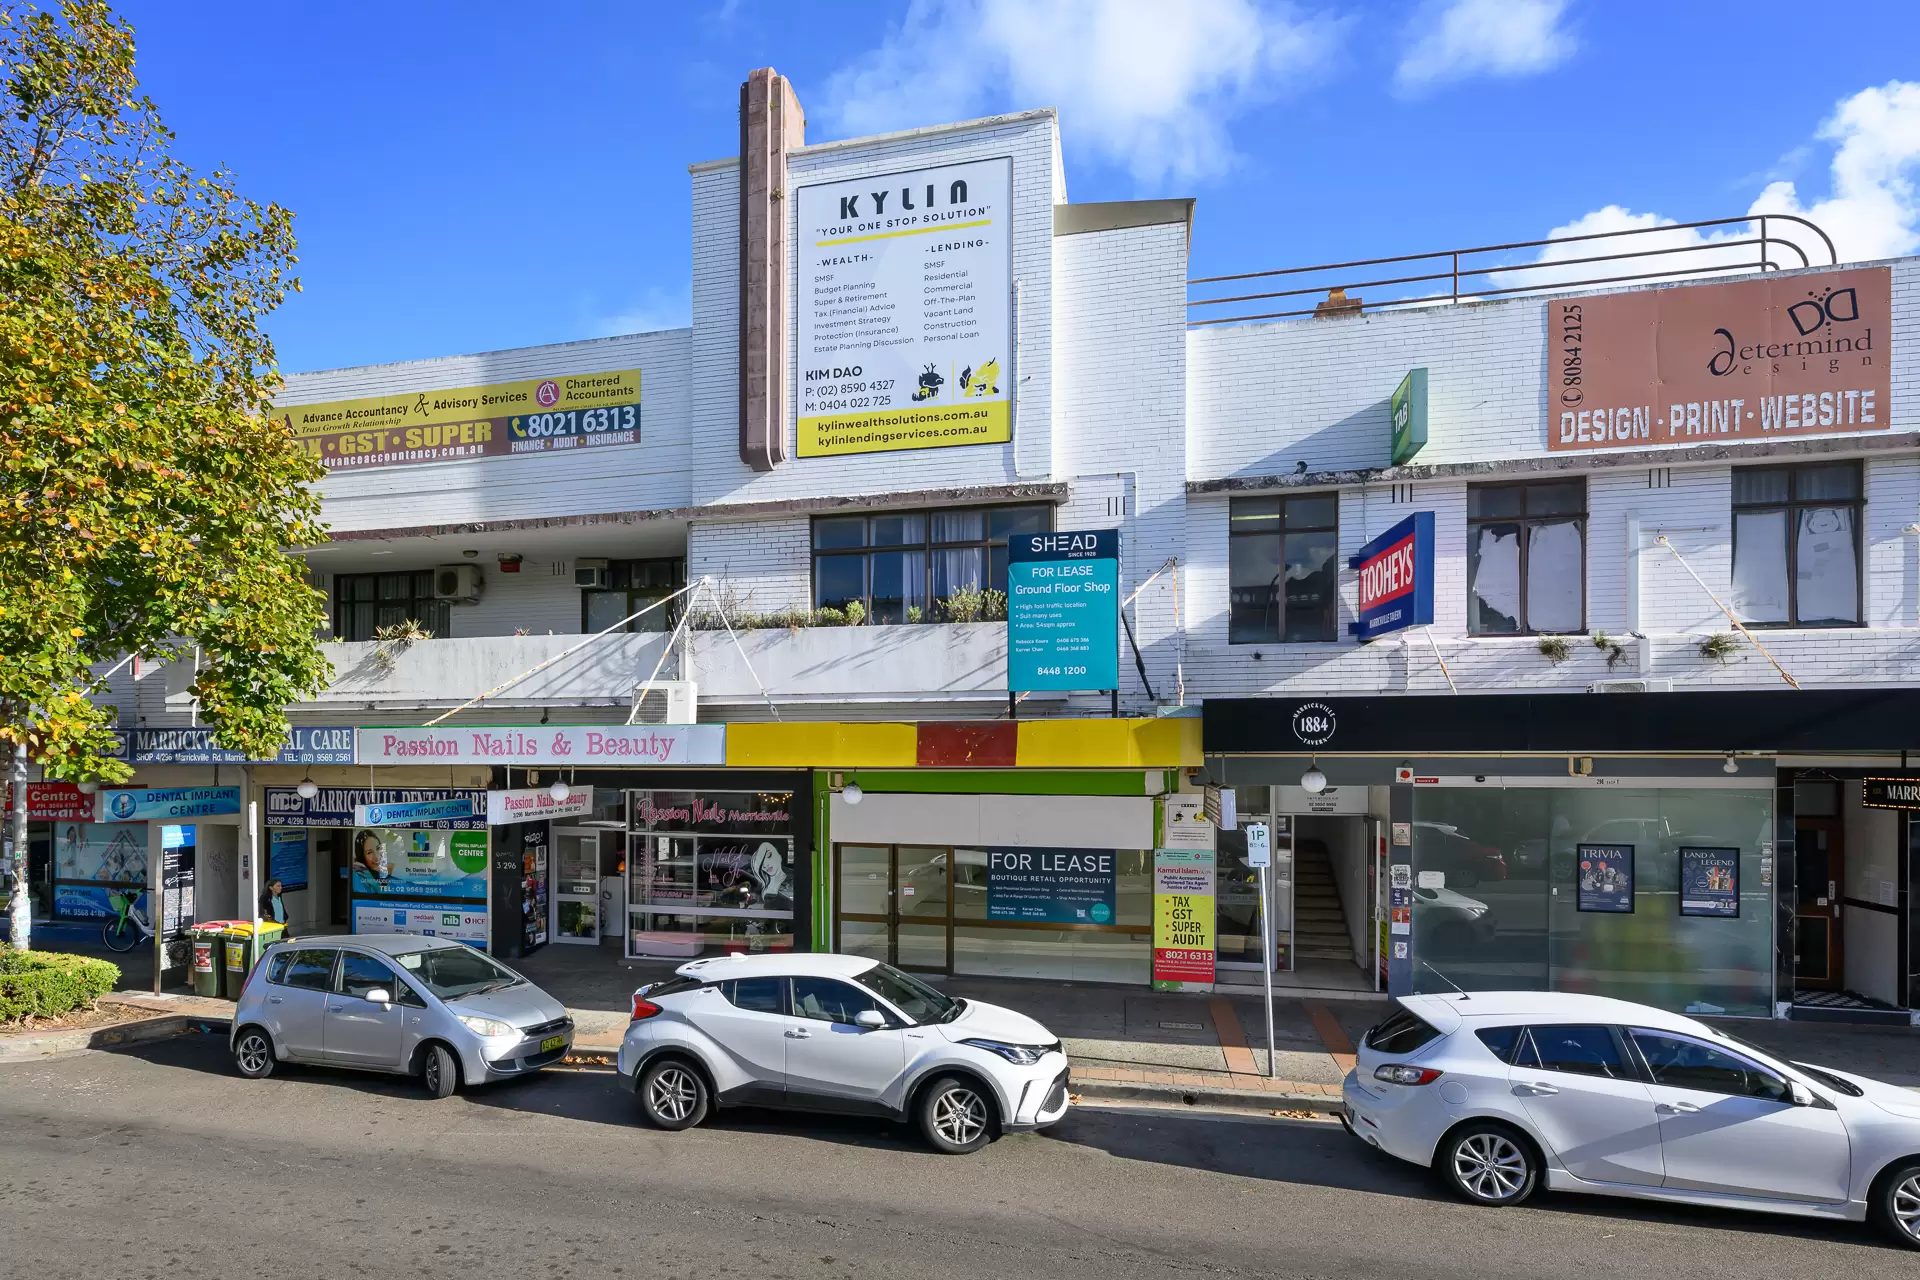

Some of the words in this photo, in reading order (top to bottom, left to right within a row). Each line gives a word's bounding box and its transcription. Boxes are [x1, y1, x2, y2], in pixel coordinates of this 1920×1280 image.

[816, 225, 853, 237] "YOUR
[858, 222, 881, 232] ONE
[886, 216, 918, 228] STOP
[923, 205, 992, 223] SOLUTION"
[924, 260, 945, 270] SMSF
[814, 274, 835, 283] SMSF
[924, 270, 968, 281] Residential
[814, 285, 841, 295] Budget
[843, 281, 876, 291] Planning
[923, 281, 973, 294] Commercial
[814, 298, 836, 307] Super
[844, 292, 888, 303] Retirement
[923, 294, 976, 306] Off-The-Plan
[829, 305, 868, 317] (Financial)
[870, 302, 896, 312] Advice
[923, 309, 952, 318] Vacant
[954, 306, 974, 315] Land
[814, 319, 856, 330] Investment
[858, 316, 891, 326] Strategy
[923, 319, 977, 331] Construction
[814, 331, 854, 341] Protection
[855, 326, 899, 338] (Insurance)
[923, 333, 958, 343] Personal
[960, 331, 980, 339] Loan
[814, 344, 838, 353] Estate
[839, 340, 872, 350] Planning
[873, 336, 915, 348] Discussion
[805, 368, 830, 381] KIM
[833, 365, 863, 379] DAO
[566, 375, 620, 390] Chartered
[805, 387, 815, 397] P:
[816, 384, 838, 397] (02)
[840, 382, 867, 394] 8590
[869, 379, 895, 392] 4327
[565, 387, 634, 401] Accountants
[303, 411, 343, 424] Advance
[345, 405, 409, 420] Accountancy
[414, 393, 430, 417] &
[433, 397, 478, 411] Advisory
[481, 391, 528, 405] Services
[805, 403, 817, 412] M:
[819, 399, 848, 411] 0404
[850, 397, 870, 409] 022
[872, 395, 891, 407] 725
[527, 411, 576, 438] 8021
[582, 405, 636, 433] 6313
[817, 410, 989, 432] kylinwealthsolutions.com.au
[1394, 402, 1408, 434] TAB
[1560, 405, 1650, 443] DESIGN
[1669, 399, 1745, 437] PRINT
[1760, 389, 1876, 431] WEBSITE
[301, 425, 321, 434] Trust
[322, 423, 351, 432] Growth
[354, 417, 402, 429] Relationship
[339, 431, 390, 455] GST
[405, 421, 492, 449] SUPER
[511, 439, 545, 452] FINANCE
[553, 436, 579, 449] AUDIT
[586, 431, 634, 446] INSURANCE
[818, 425, 988, 448] kylinlendingservices.com.au
[1031, 534, 1097, 553] SHEAD
[1032, 567, 1054, 578] FOR
[1057, 566, 1093, 577] LEASE
[1361, 542, 1413, 604] TOOHEYS
[1015, 583, 1051, 595] Ground
[1054, 582, 1081, 593] Floor
[1084, 582, 1111, 594] Shop
[1037, 667, 1061, 676] 8448
[1064, 666, 1087, 675] 1200
[1292, 702, 1336, 719] MARRICKVILLE
[1301, 716, 1329, 733] 1884
[136, 730, 223, 750] MARRICKV
[310, 730, 351, 751] CARE
[383, 734, 459, 757] Passion
[472, 732, 538, 756] Nails
[551, 732, 572, 756] &
[586, 732, 676, 762] Beauty
[1302, 737, 1328, 746] TAVERN
[136, 753, 153, 761] SHOP
[155, 753, 172, 761] 4/296
[175, 753, 210, 762] Marrickville
[212, 753, 223, 761] Rd.
[284, 753, 298, 762] TEL:
[301, 753, 314, 763] (02)
[317, 753, 333, 762] 9569
[336, 753, 351, 762] 2561
[31, 791, 79, 801] Centre
[147, 791, 188, 803] DENTAL
[191, 790, 235, 800] IMPLANT
[1886, 785, 1920, 800] MARR
[169, 803, 216, 815] CENTRE
[504, 795, 534, 811] Passion
[536, 793, 555, 808] Nails
[565, 793, 587, 806] Beauty
[386, 810, 414, 820] DENTAL
[415, 808, 445, 817] IMPLANT
[446, 804, 469, 814] CENTRE
[637, 797, 689, 824] Passion
[692, 798, 726, 824] Nails
[728, 810, 790, 822] Marrickville
[267, 816, 285, 825] SHOP
[287, 817, 304, 826] 4/296
[306, 817, 341, 826] Marrickville
[343, 817, 354, 826] Rd.
[420, 820, 434, 829] TEL:
[436, 820, 450, 830] (02)
[453, 820, 470, 830] 9569
[1251, 830, 1265, 841] 1P
[1582, 849, 1623, 859] TRIVIA
[503, 862, 517, 870] 296
[991, 853, 1032, 871] FOR
[1041, 854, 1111, 873] LEASE
[1701, 859, 1735, 867] LEGEND
[1157, 866, 1181, 875] Kamrul
[1181, 867, 1199, 875] Islam
[991, 874, 1028, 882] BOUTIQUE
[1172, 896, 1190, 908] TAX
[443, 915, 459, 925] nib
[1172, 909, 1193, 920] GST
[1172, 921, 1202, 933] SUPER
[1172, 933, 1206, 946] AUDIT
[1165, 950, 1187, 959] 8021
[1190, 952, 1213, 961] 6313
